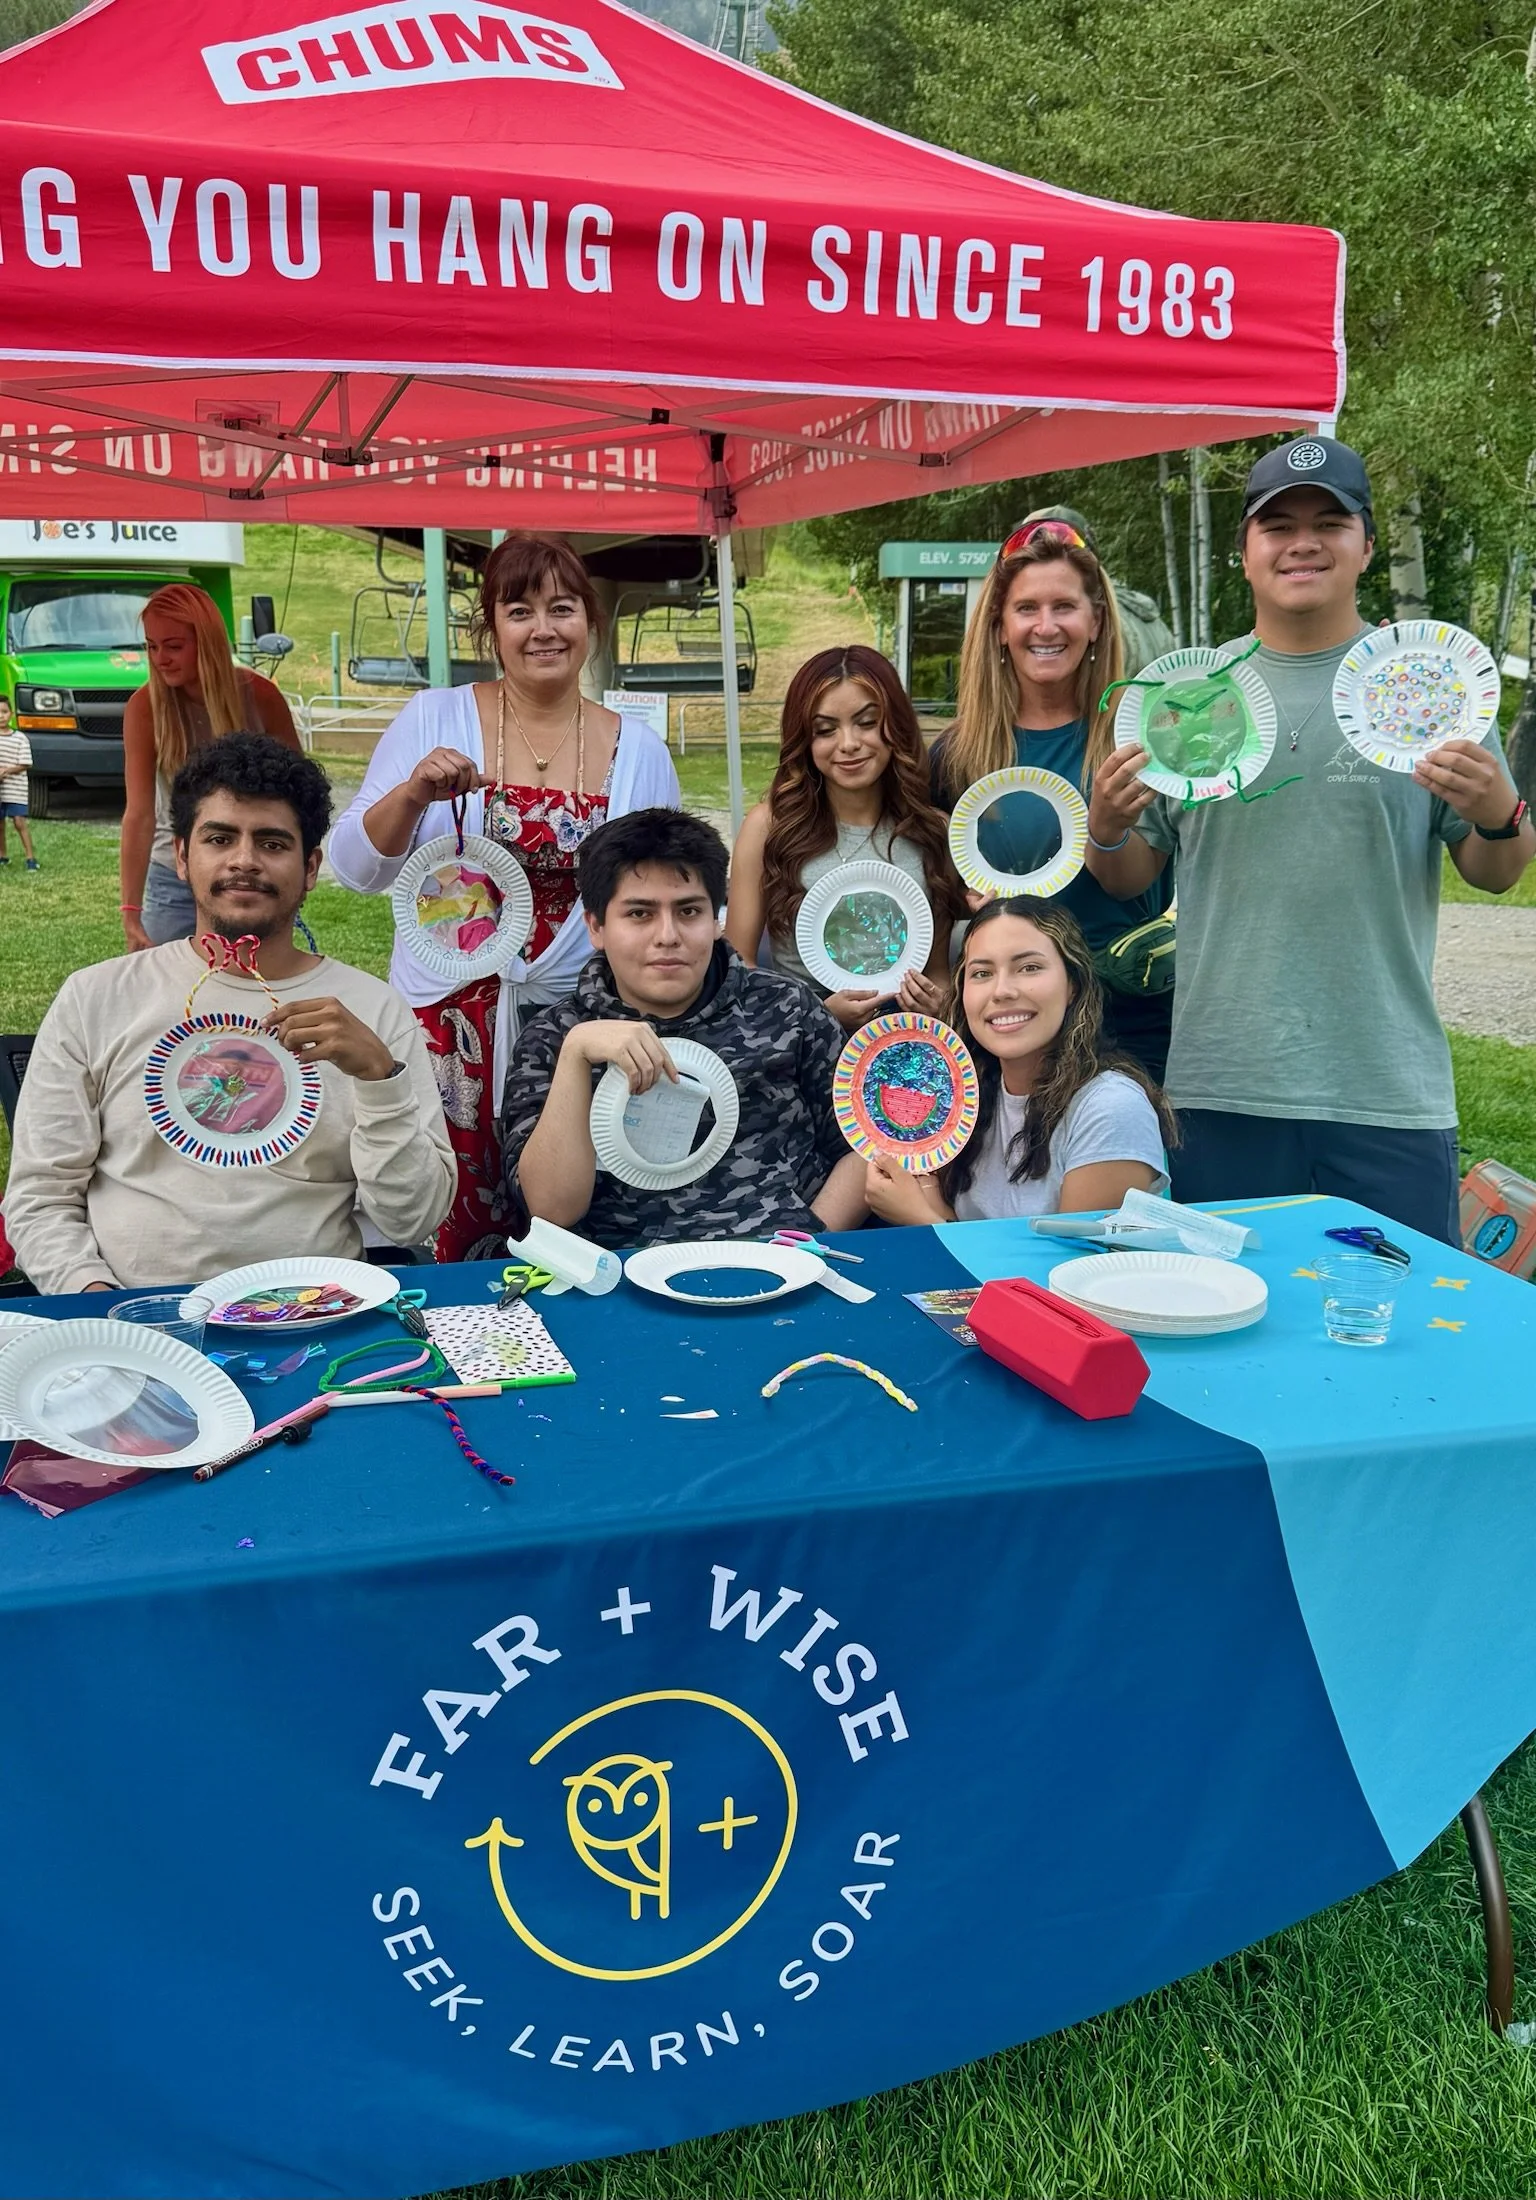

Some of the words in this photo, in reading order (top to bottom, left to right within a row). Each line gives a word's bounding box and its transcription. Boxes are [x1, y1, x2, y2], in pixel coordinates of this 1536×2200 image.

[236, 13, 589, 92] CHUMS
[0, 167, 82, 269] G
[129, 175, 321, 280] YOU
[373, 191, 613, 294] HANG
[658, 212, 767, 306] ON
[808, 225, 1045, 329] SINCE
[1081, 257, 1236, 341] 1983
[111, 520, 178, 543] Juice
[919, 551, 953, 564] ELEV.
[614, 693, 658, 705] CAUTION
[1326, 775, 1348, 783] COVE
[369, 1615, 562, 1800] FAR
[708, 1564, 909, 1763] WISE
[372, 1887, 484, 2037] SEEK,
[509, 2011, 766, 2074] LEARN,
[779, 1832, 901, 2001] SOAR
